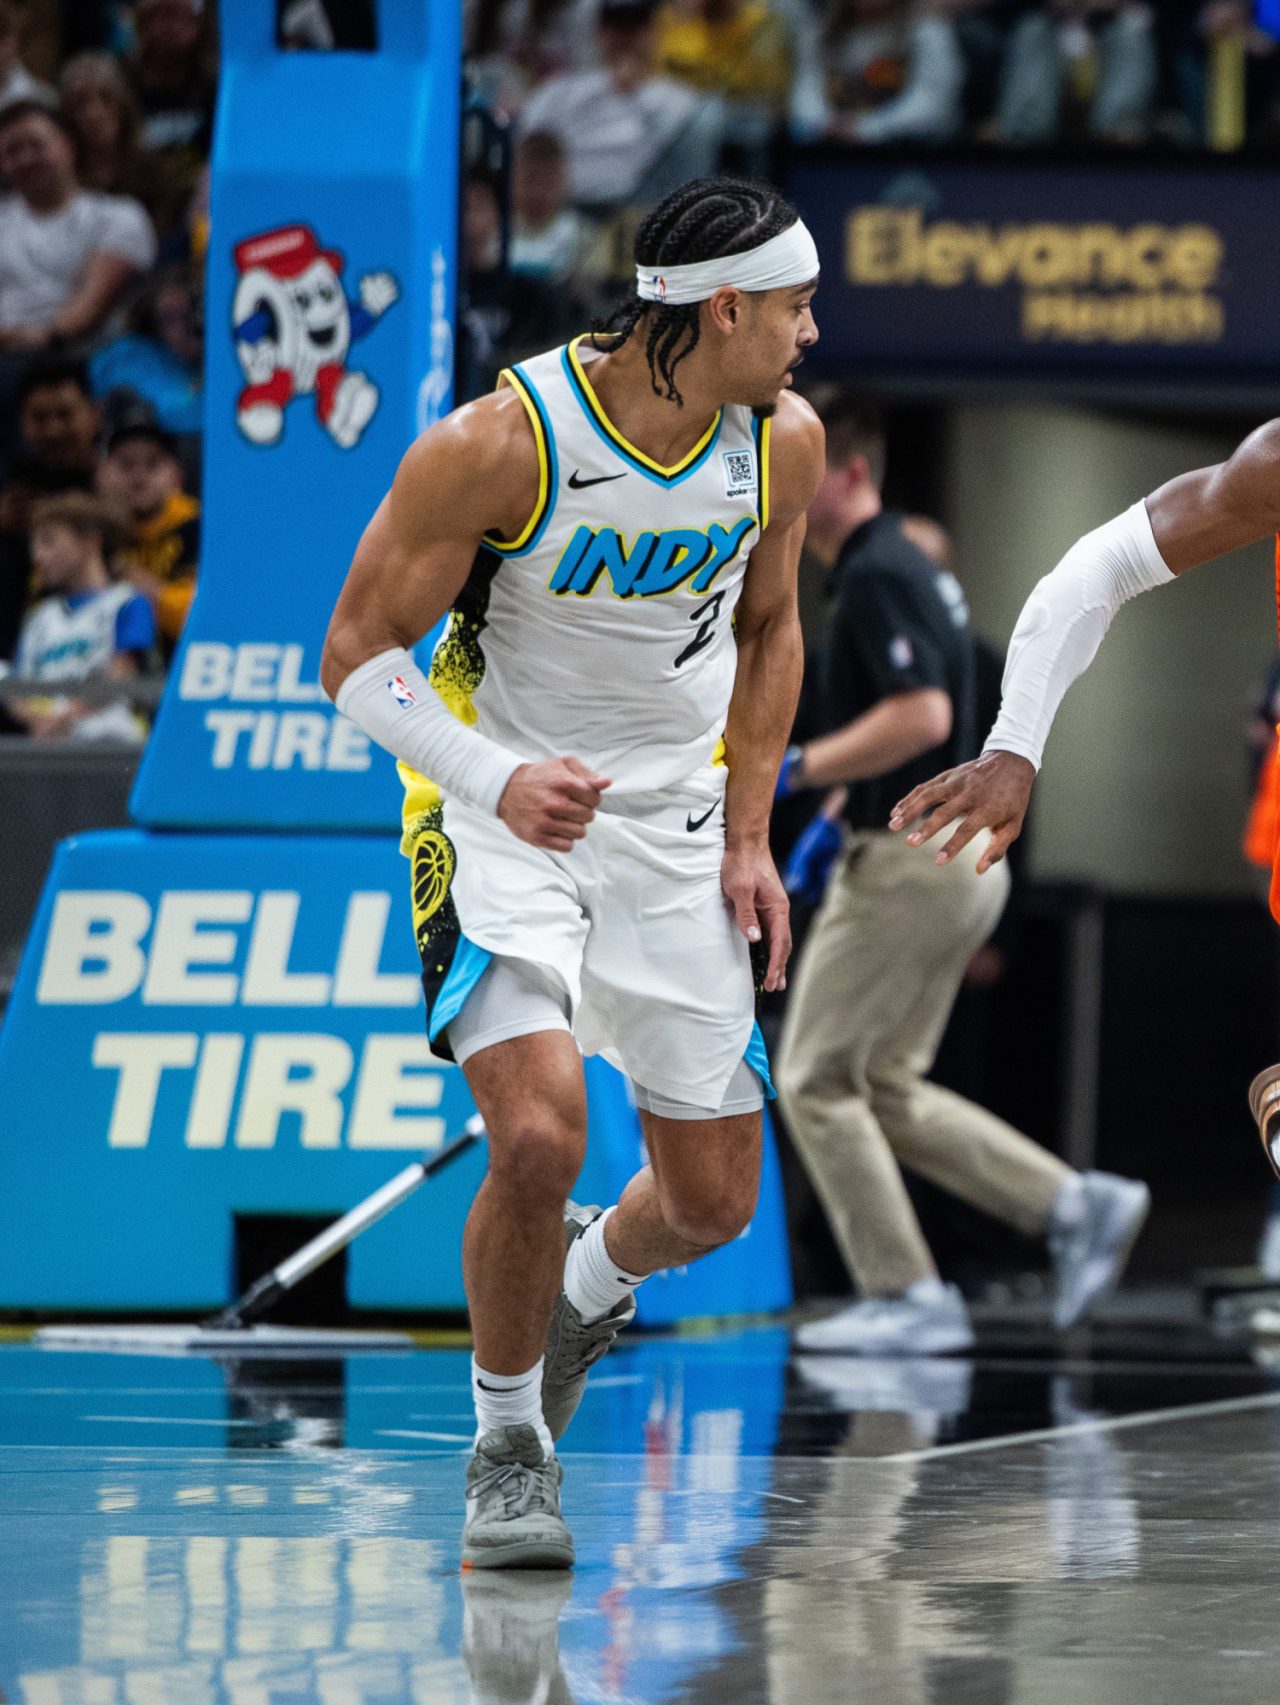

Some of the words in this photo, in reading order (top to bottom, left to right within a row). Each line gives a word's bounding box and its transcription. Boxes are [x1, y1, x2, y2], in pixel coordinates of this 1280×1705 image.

[846, 205, 1223, 287] Elevance
[547, 514, 758, 600] INDY
[674, 590, 726, 668] 2
[179, 641, 335, 703] BEL
[205, 710, 372, 771] TIRE
[37, 890, 421, 1007] BELL
[92, 1032, 447, 1150] TIRE
